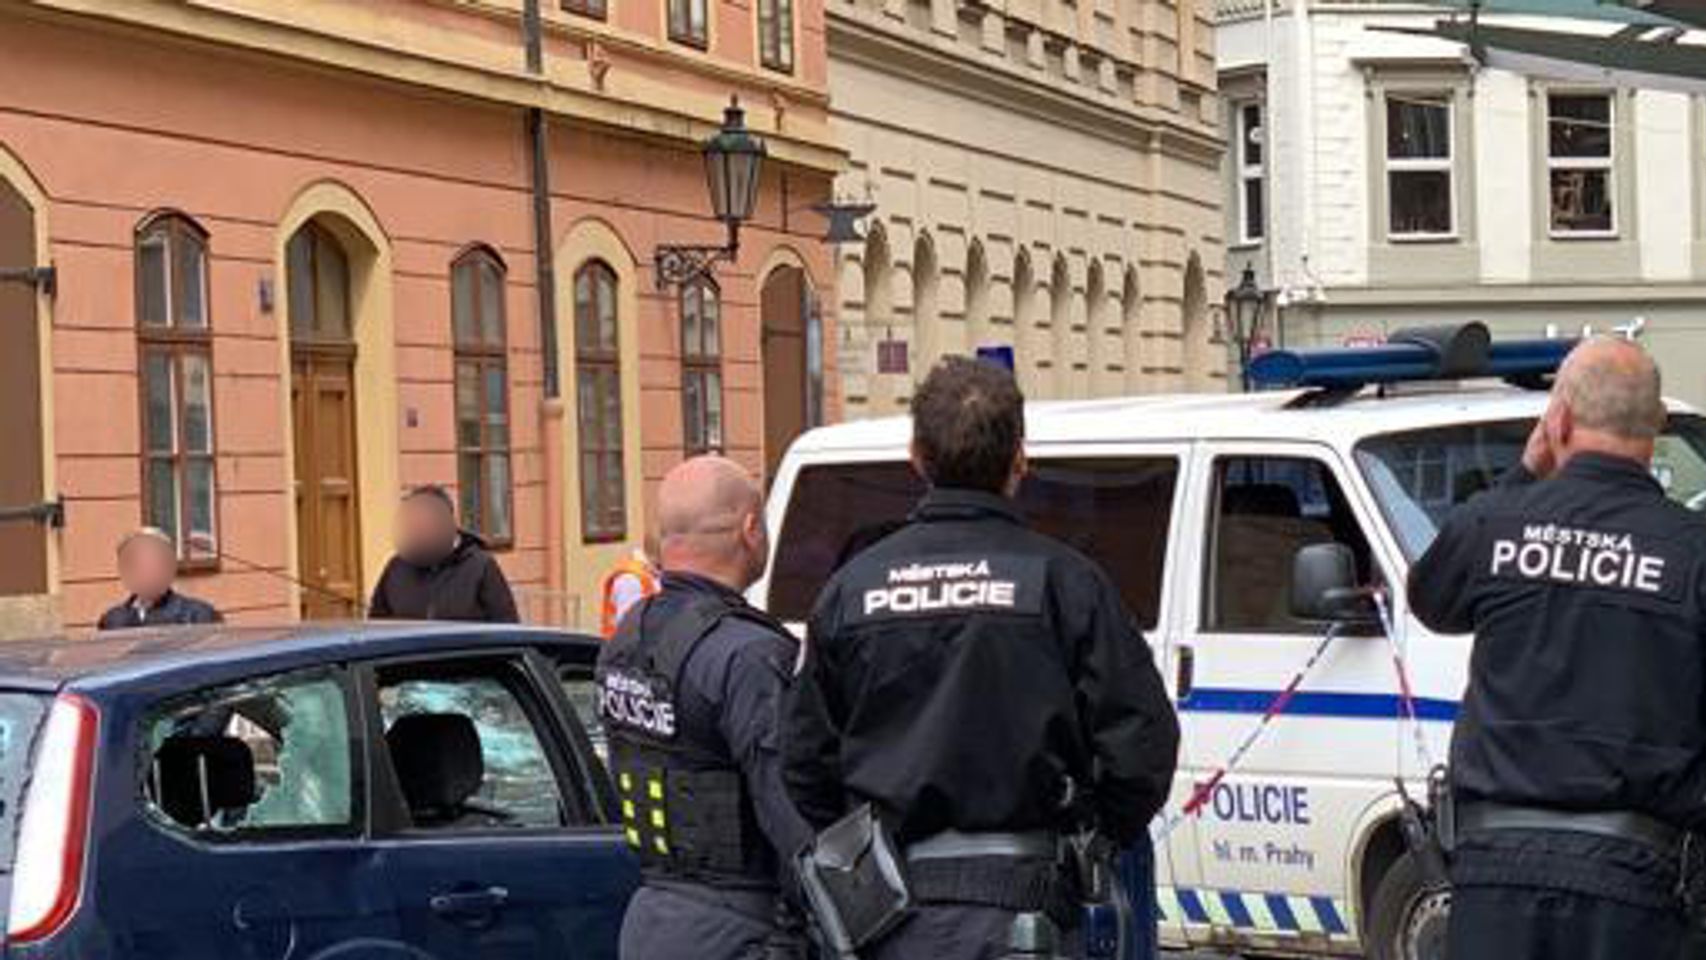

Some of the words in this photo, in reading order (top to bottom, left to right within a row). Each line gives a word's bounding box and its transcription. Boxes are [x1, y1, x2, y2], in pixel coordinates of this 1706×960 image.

[1524, 525, 1632, 550] MĚSTSKÁ
[1491, 540, 1665, 592] POLICIE
[864, 581, 1015, 615] POLICIE
